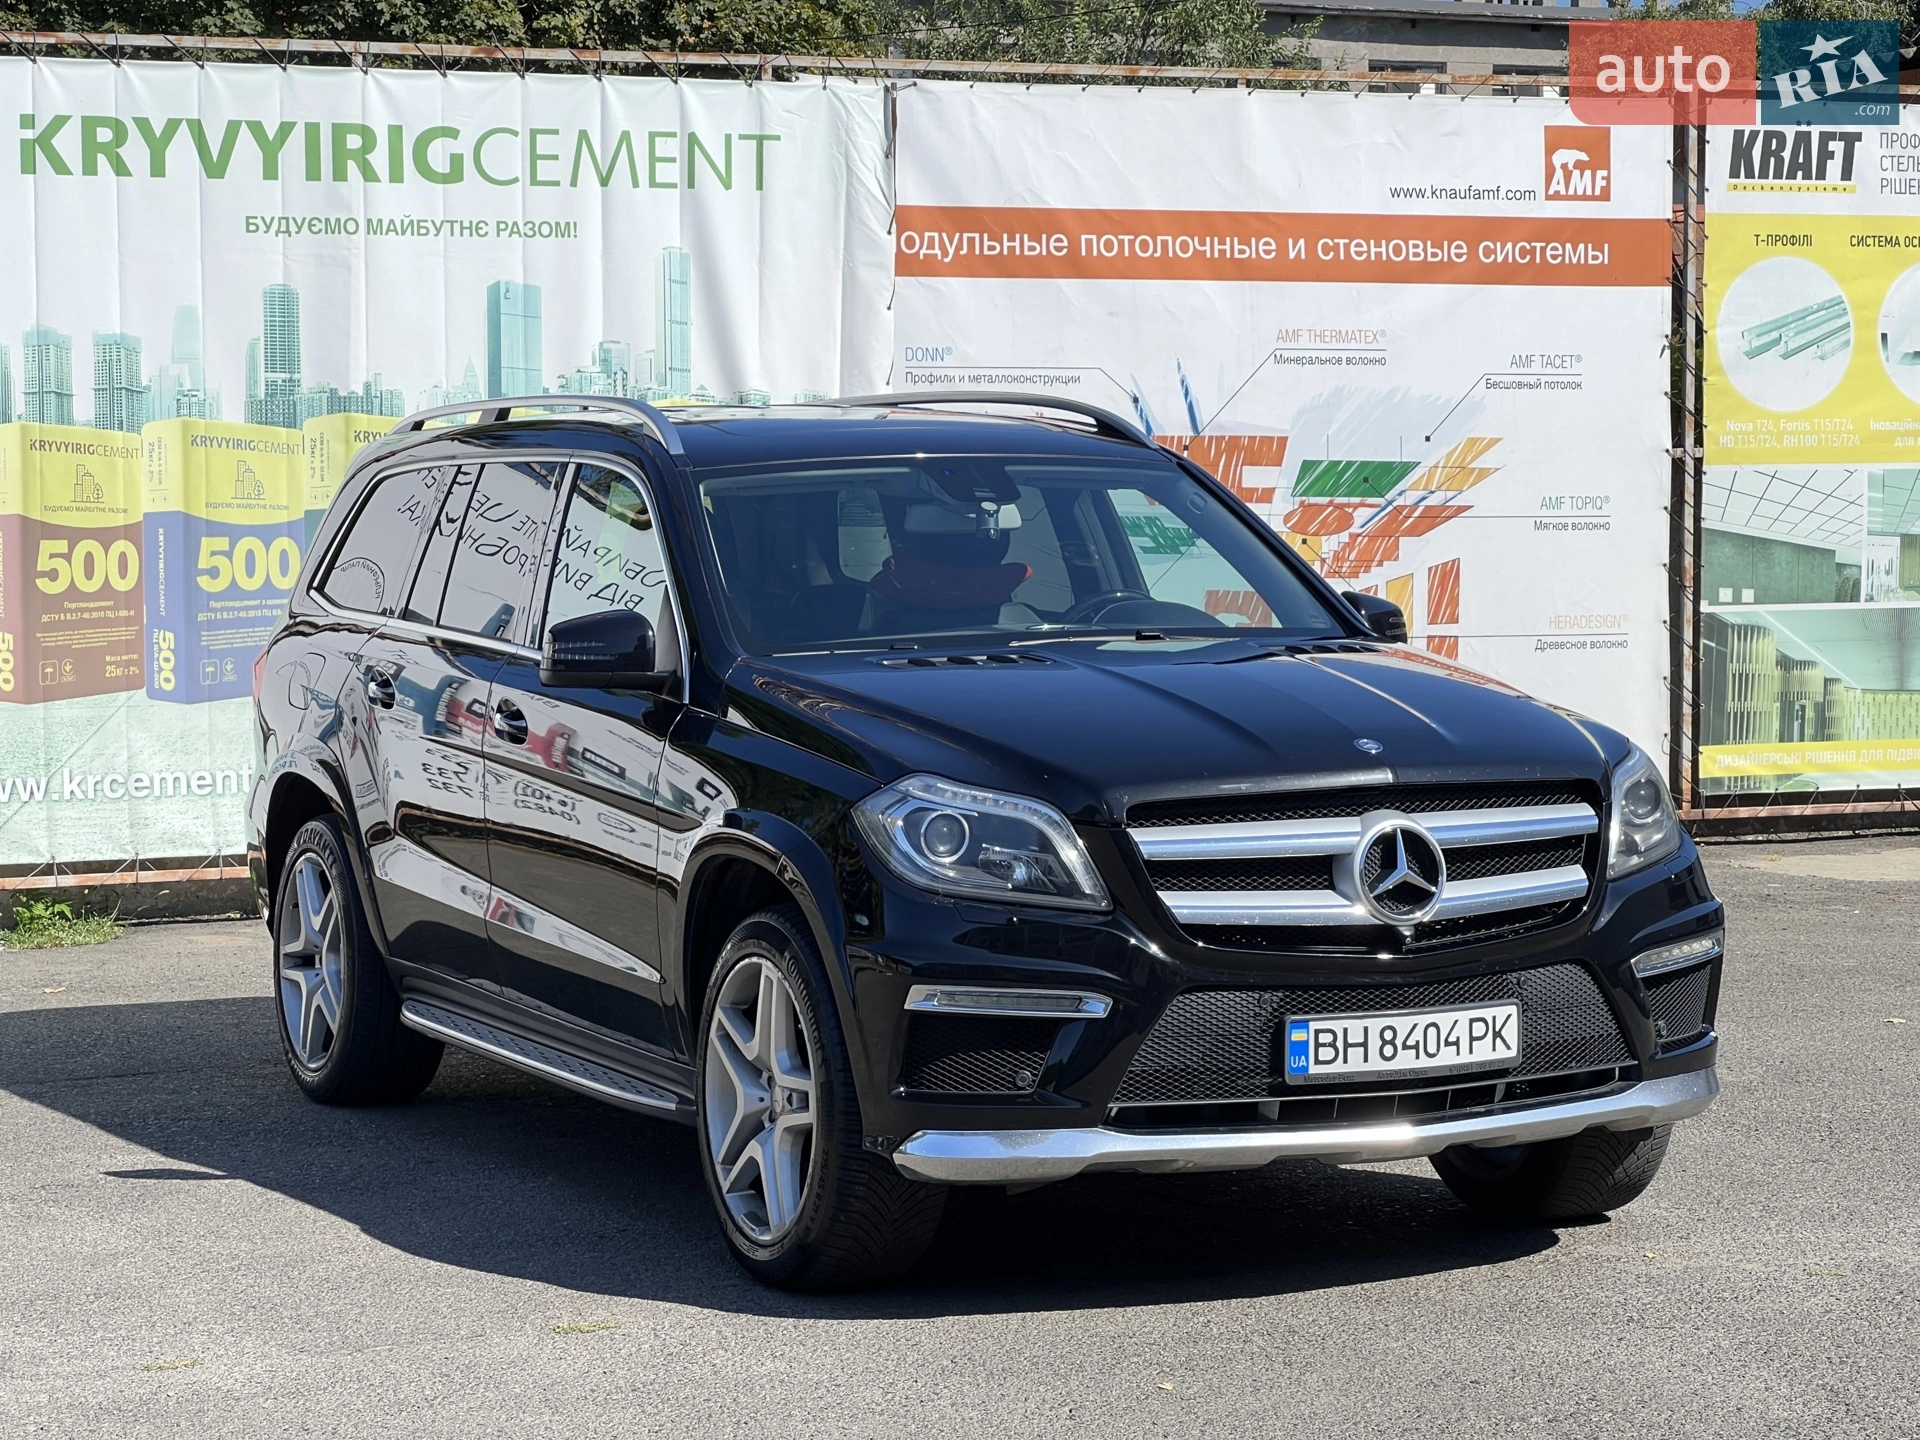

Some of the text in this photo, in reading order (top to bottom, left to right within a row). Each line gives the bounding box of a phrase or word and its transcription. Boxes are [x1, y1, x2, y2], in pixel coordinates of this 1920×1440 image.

[1548, 169, 1609, 197] AMF
[1389, 185, 1537, 202] www.knaufamf.com
[245, 214, 579, 239] БУДУЄМО МАЙБУТНЄ РАЗОМ!
[1754, 234, 1813, 247] Т-ПРОФІЛІ
[1849, 235, 1901, 248] СИСТЕМА
[1080, 233, 1277, 260] потолочные
[1287, 238, 1306, 261] и
[1317, 236, 1469, 264] стеновые
[1478, 239, 1610, 265] системы
[1276, 328, 1304, 345] AMF
[1273, 352, 1387, 367] Минеральное волокно
[1510, 353, 1537, 370] AMF
[904, 371, 1081, 387] Профили и металлоконструкции
[1485, 376, 1583, 390] Бесшовный потолок
[1726, 420, 1753, 431] Nova
[1780, 419, 1810, 431] Fortis
[1813, 419, 1854, 431] T15/T24
[1719, 435, 1735, 448] HD
[1783, 434, 1818, 447] RH100
[1820, 434, 1860, 447] T15/T24
[1540, 496, 1566, 511] AMF
[1534, 520, 1611, 532] Мягкое волокно
[35, 539, 140, 595] 500
[196, 536, 301, 593] 500
[1535, 639, 1629, 653] Древесное волокно
[159, 629, 176, 692] 500
[1715, 751, 1801, 769] ДИЗАЙНЕРСЬКІ
[1805, 750, 1856, 764] РІШЕННЯ
[1859, 749, 1884, 764] ДЛЯ
[1378, 1018, 1461, 1063] 8404
[1290, 1055, 1308, 1069] UA
